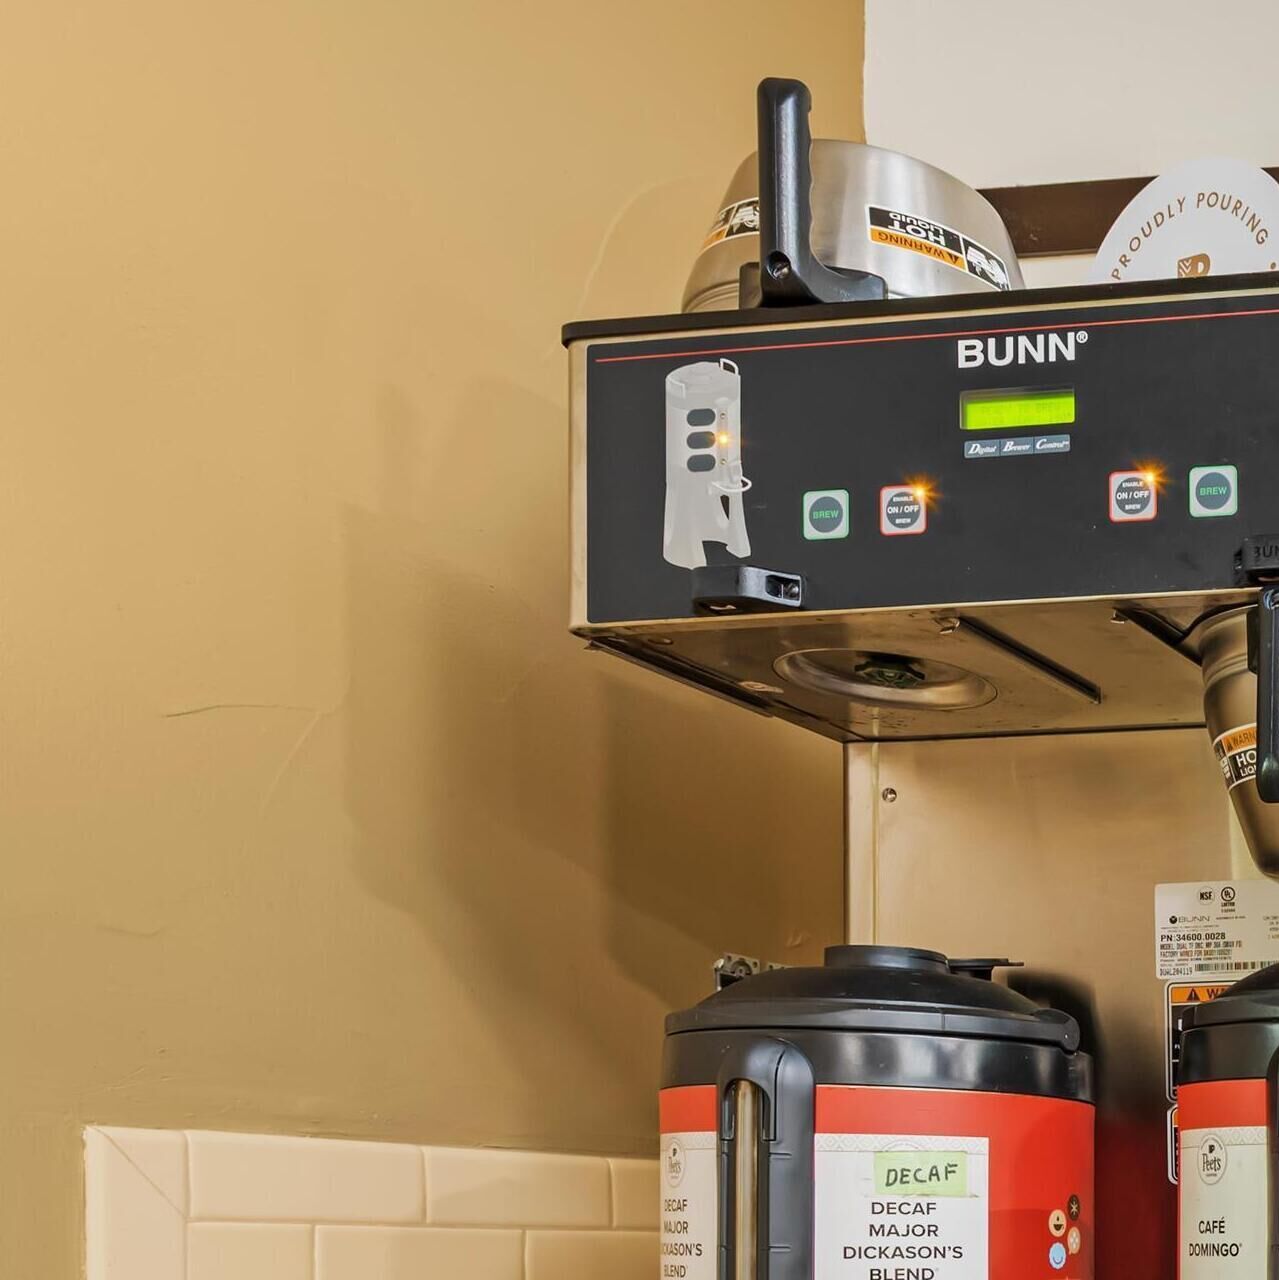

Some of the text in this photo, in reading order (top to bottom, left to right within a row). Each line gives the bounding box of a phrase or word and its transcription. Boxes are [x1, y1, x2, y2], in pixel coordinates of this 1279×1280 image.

[889, 212, 944, 235] LIQUID
[888, 220, 946, 246] HOT
[1111, 191, 1269, 281] PROUDLY POURING
[879, 232, 945, 259] WARNING
[1199, 485, 1228, 496] BREW
[813, 509, 839, 520] BREW
[885, 1162, 958, 1188] DECAF
[870, 1201, 937, 1216] DECAF
[869, 1222, 939, 1238] MAJOR
[1198, 1216, 1226, 1235] CAFÉ
[843, 1244, 964, 1260] DICKASON'S
[1189, 1243, 1240, 1257] DOMINGO
